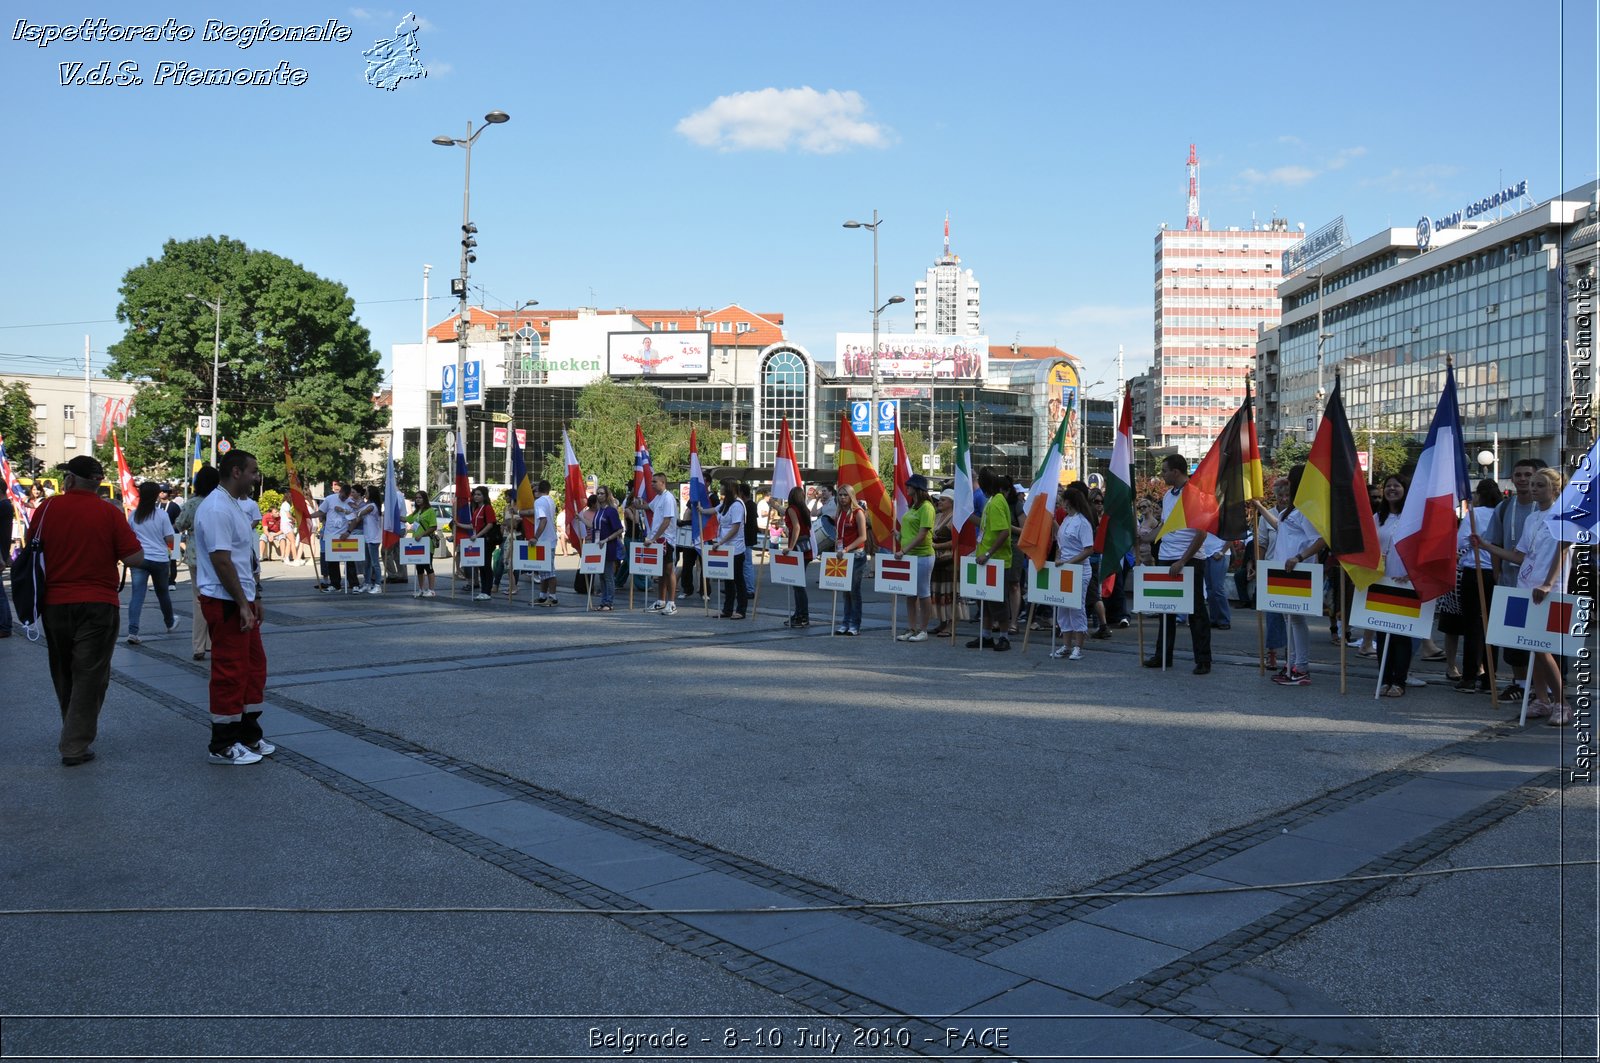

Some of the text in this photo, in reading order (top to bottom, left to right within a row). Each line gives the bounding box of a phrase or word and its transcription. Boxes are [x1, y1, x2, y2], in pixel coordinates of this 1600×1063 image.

[1435, 180, 1527, 232] DUNAV OSIGURANJE
[1315, 226, 1339, 251] BANK
[521, 356, 600, 372] Heineken
[976, 589, 987, 598] Italy
[1044, 594, 1065, 604] Ireland
[1149, 602, 1177, 611] Hungary
[1269, 600, 1309, 612] Germany II
[1367, 616, 1413, 632] Germany I
[1516, 635, 1552, 649] France
